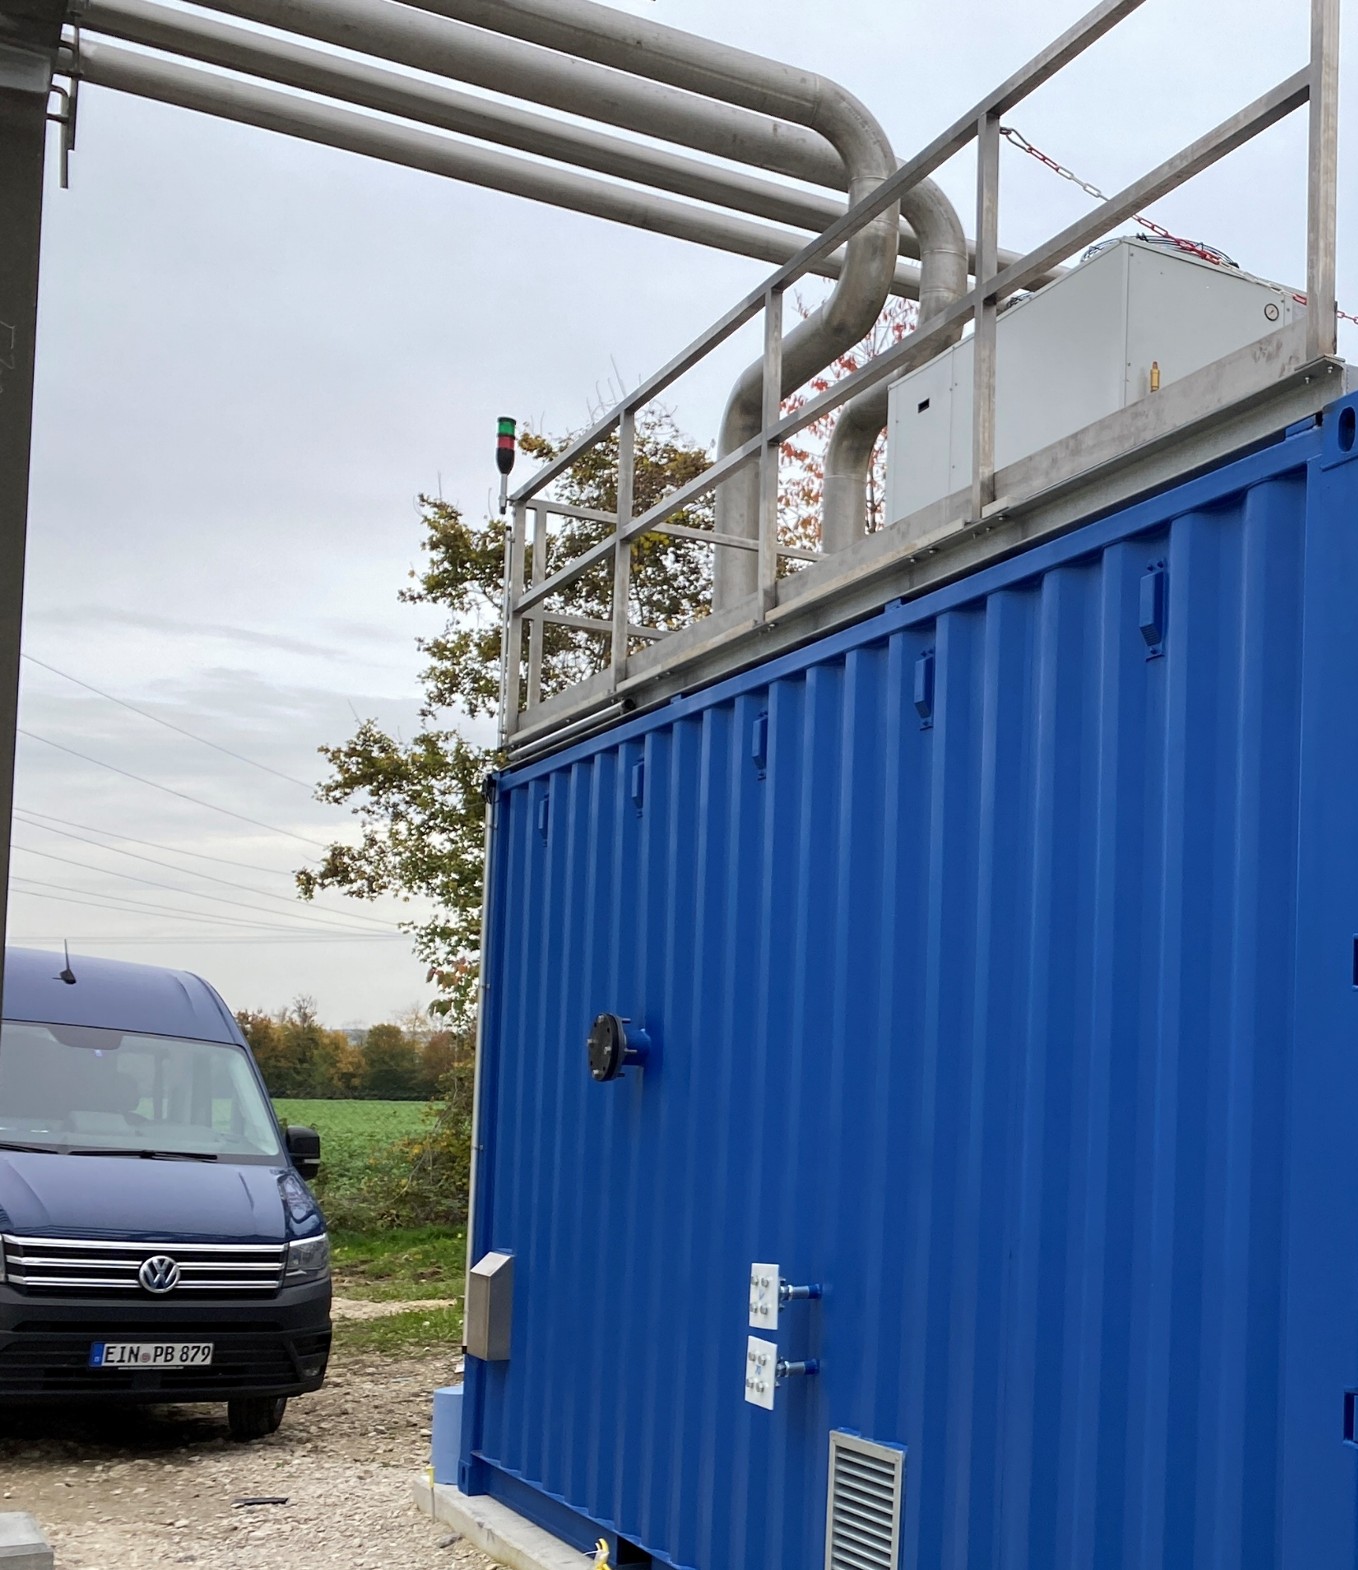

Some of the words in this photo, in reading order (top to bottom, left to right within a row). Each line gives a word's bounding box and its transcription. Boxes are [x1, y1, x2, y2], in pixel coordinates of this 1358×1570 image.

[104, 1345, 140, 1363] EIN
[152, 1345, 175, 1363] PB
[180, 1345, 211, 1363] 879
